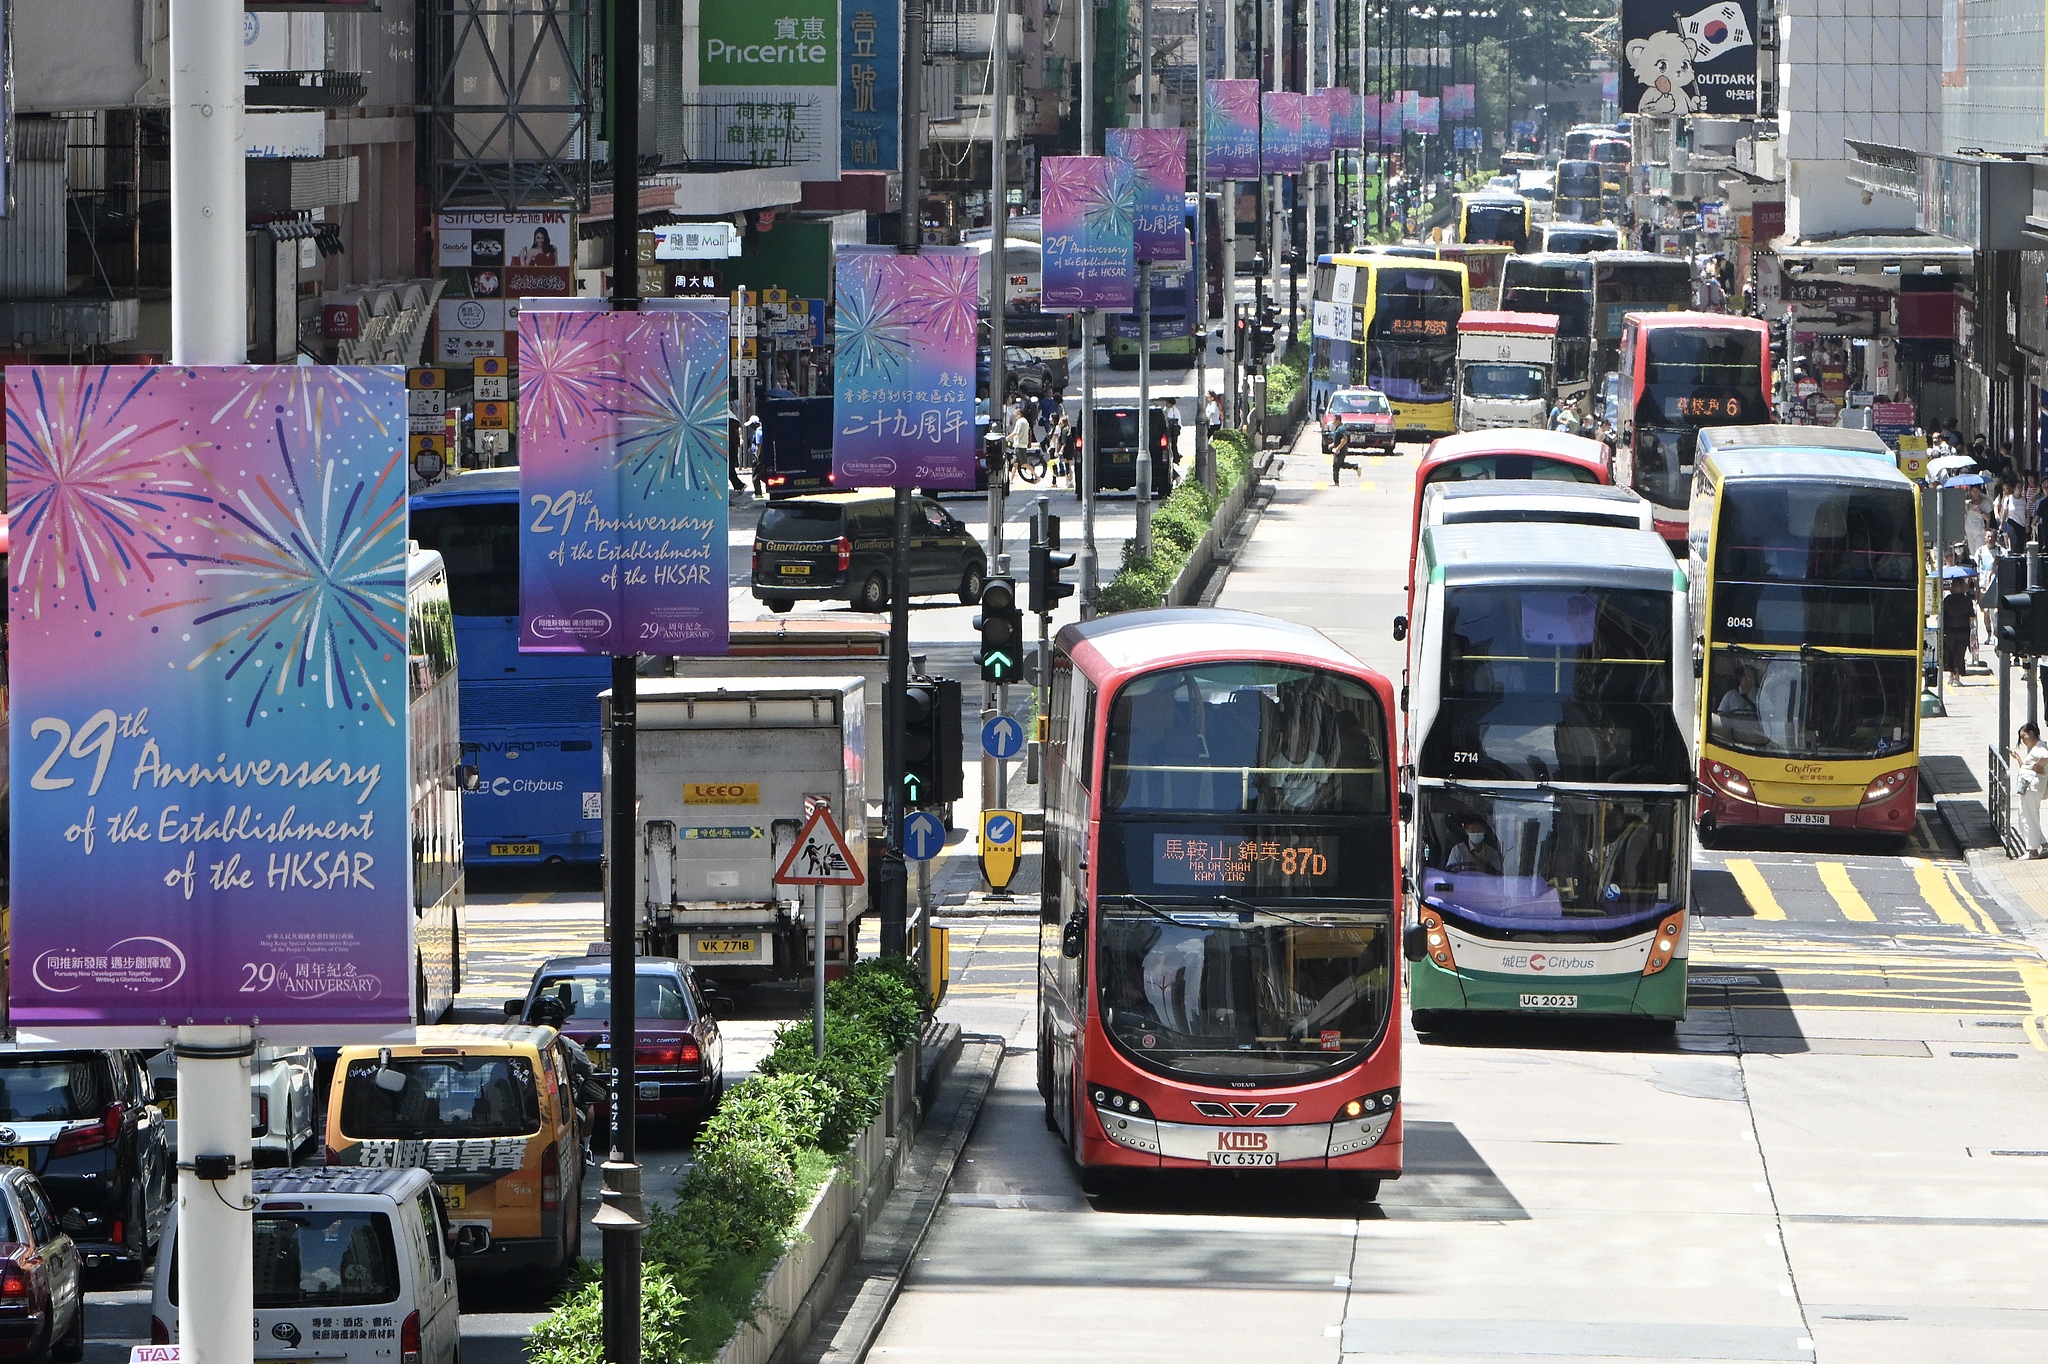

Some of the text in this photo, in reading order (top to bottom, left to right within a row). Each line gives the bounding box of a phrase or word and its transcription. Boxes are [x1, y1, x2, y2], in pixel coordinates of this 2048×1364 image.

[774, 16, 826, 41] 實惠
[707, 38, 827, 63] Pricerite
[1697, 74, 1755, 85] OUTDARK
[1725, 89, 1755, 100] 아웃닭
[727, 125, 806, 144] 商業中心
[701, 234, 725, 247] Mall
[1046, 235, 1074, 255] 29th
[1070, 242, 1128, 258] Anniversary
[1054, 257, 1127, 269] of the Establishment
[1077, 267, 1127, 279] of the HKSAR
[675, 275, 715, 288] 周大福
[433, 391, 439, 399] 7
[481, 388, 502, 397] 終止
[844, 388, 967, 404] 香港特別行政區成立
[433, 404, 439, 413] 8
[1726, 397, 1738, 416] 6
[842, 407, 968, 444] 二十九周年
[530, 489, 594, 536] 29th
[584, 505, 715, 540] Anniversary
[766, 541, 824, 552] Guardforce
[854, 540, 890, 549] Guardforce
[548, 540, 711, 566] of the Establishment
[600, 564, 711, 591] of the HKSAR
[1727, 617, 1753, 628] 8043
[663, 630, 711, 638] ANNIVERSARY
[30, 707, 151, 797] 29th
[1453, 752, 1478, 763] 5714
[132, 739, 382, 805] Anniversary
[512, 779, 564, 793] Citybus
[1790, 815, 1825, 824] SN 8318
[64, 805, 375, 855] of the Establishment
[496, 845, 535, 854] TR 9241
[1162, 839, 1327, 876] 馬鞍山 錦英 87D
[1189, 862, 1251, 872] MA ON SHAN
[163, 851, 375, 900] of the HKSAR
[1194, 872, 1245, 882] KAM YING
[702, 941, 749, 950] VK 7718
[47, 956, 172, 969] 同推新發展 邁步創輝煌
[1501, 955, 1595, 969] 城巴 Citybus
[295, 962, 357, 978] 周年紀念
[284, 977, 374, 992] ANNIVERSARY
[1522, 996, 1574, 1006] UG 2023
[1218, 1132, 1268, 1151] KMB
[1213, 1154, 1273, 1165] VC 6370
